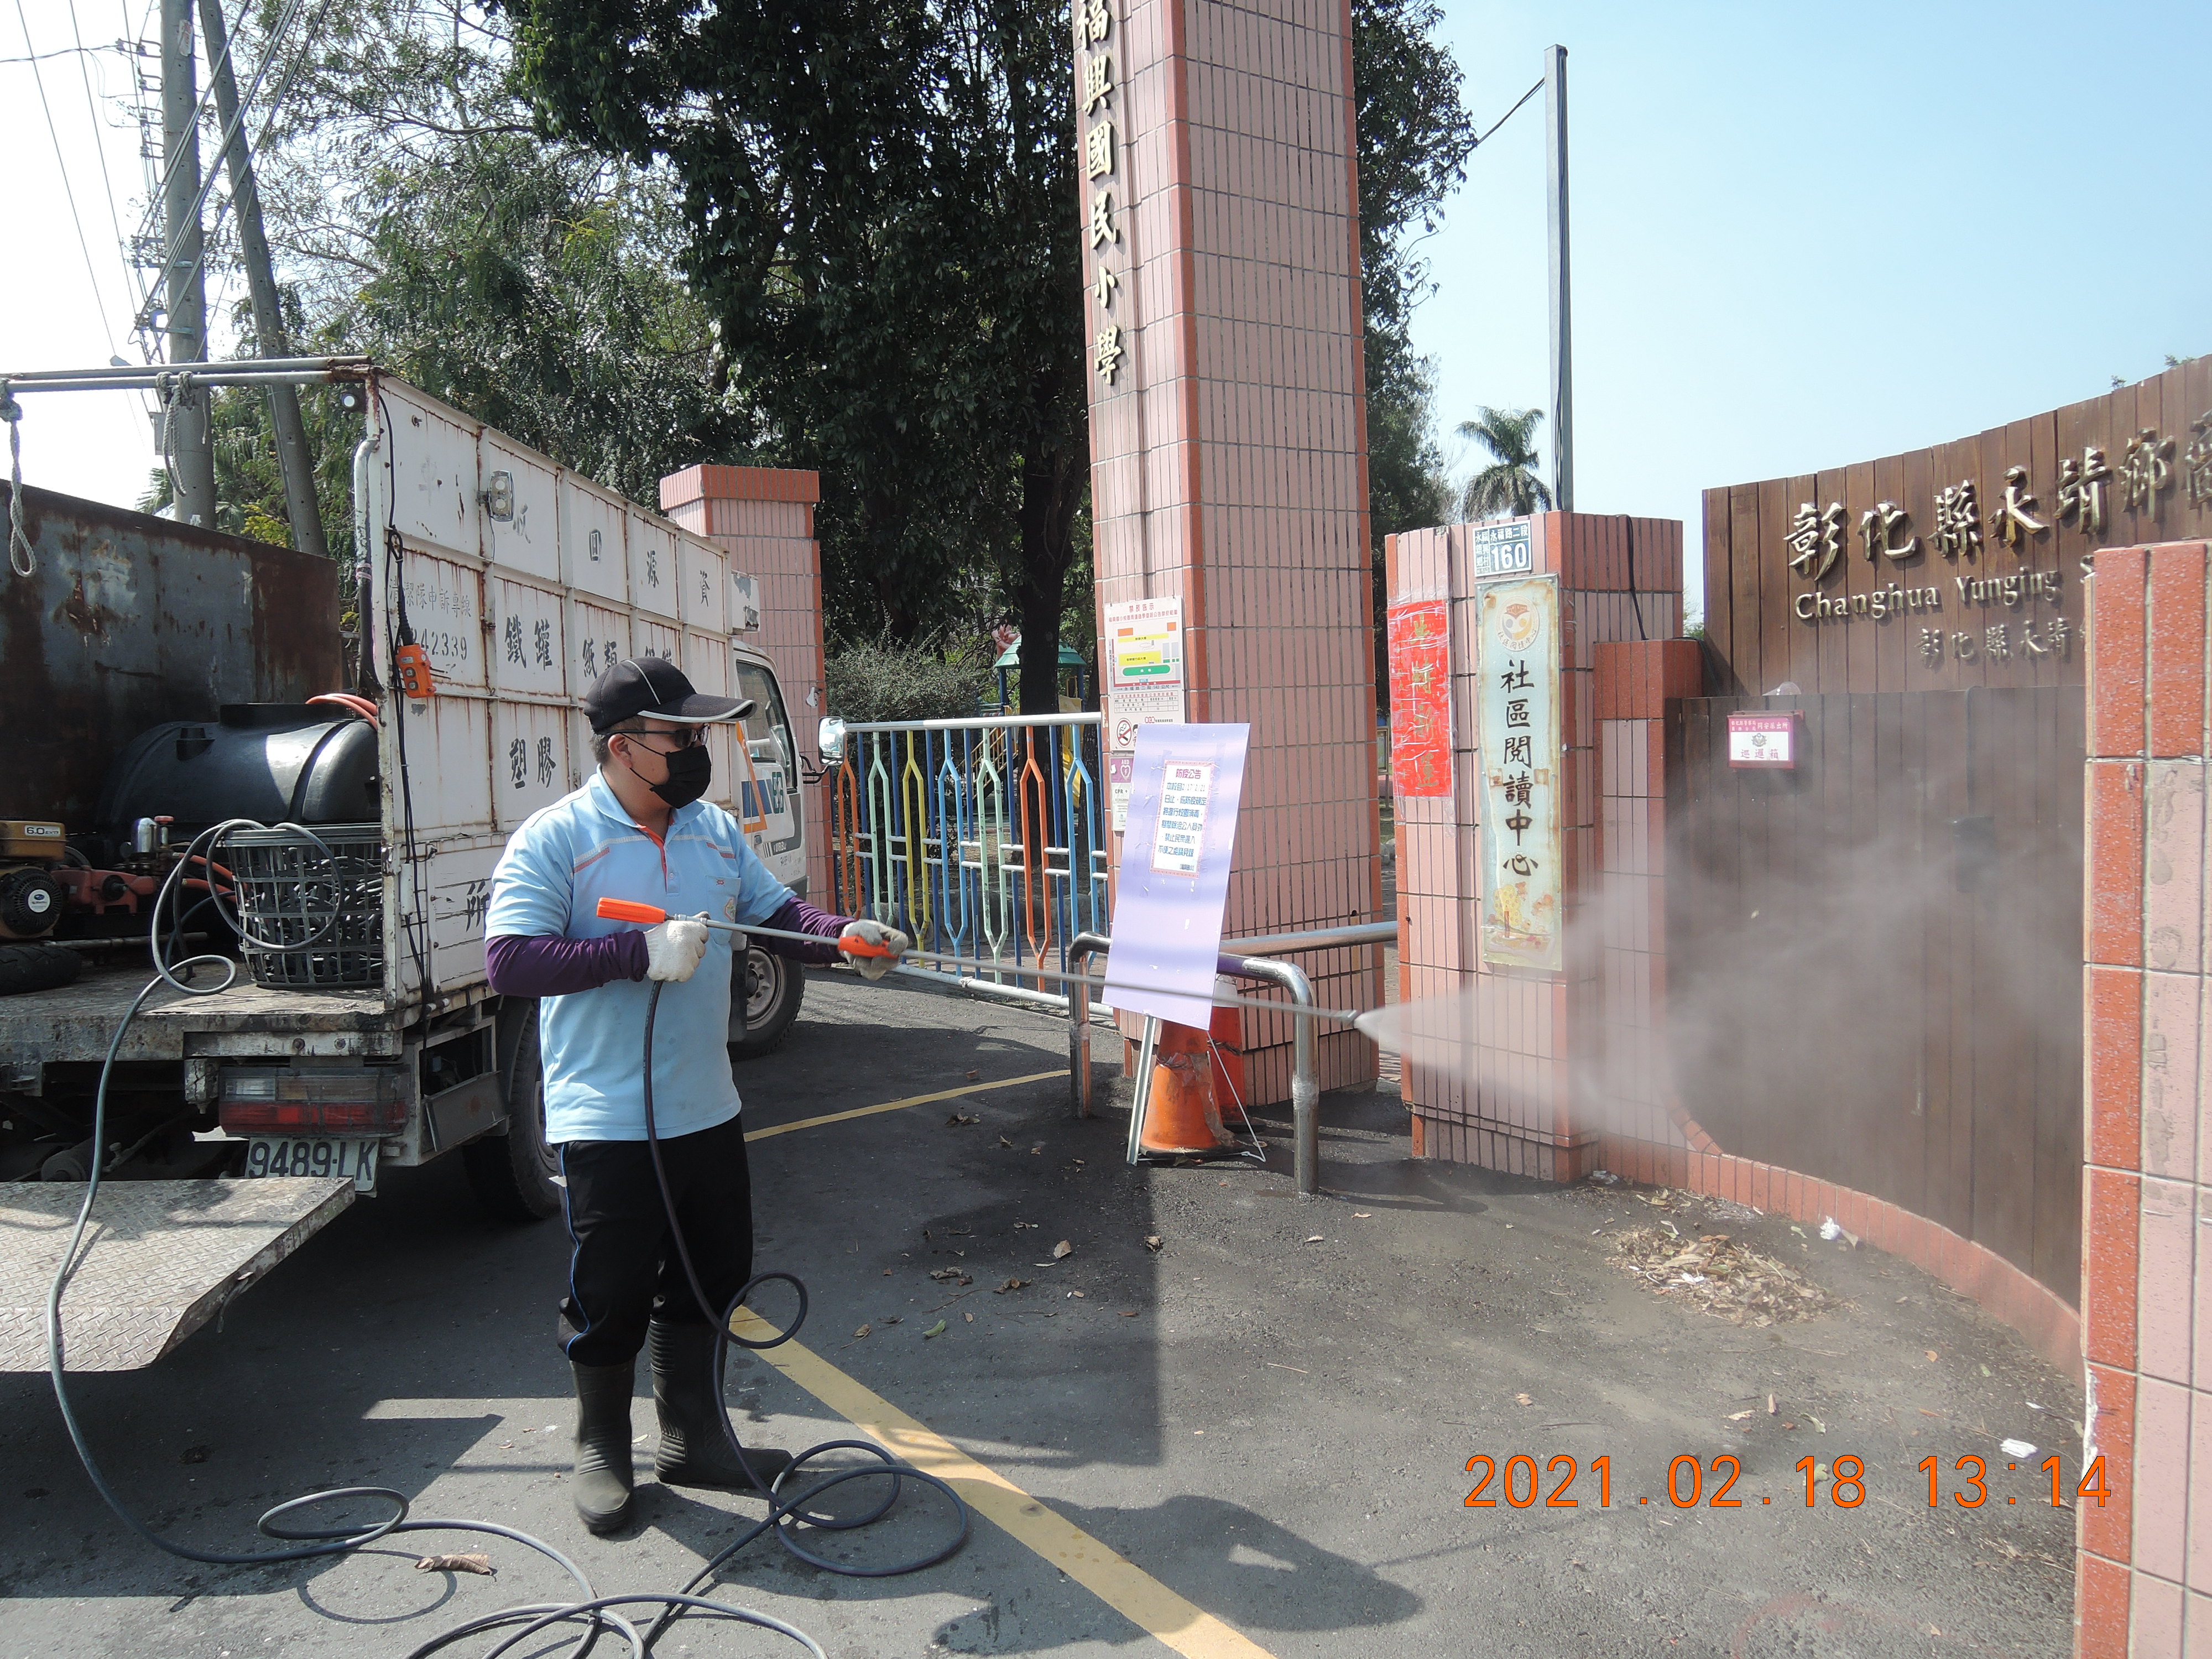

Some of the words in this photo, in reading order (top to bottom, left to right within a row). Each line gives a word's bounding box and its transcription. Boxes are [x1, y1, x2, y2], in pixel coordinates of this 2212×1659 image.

[1076, 0, 1125, 386] 福興國民小學
[1490, 524, 1528, 541] 永福路二段
[1491, 542, 1527, 571] 160
[1795, 583, 1941, 620] Changhua
[504, 614, 553, 669] 鐵罐
[1915, 617, 2086, 668] 彰化縣永靖
[509, 737, 556, 790] 塑膠
[1500, 659, 1538, 877] 社區閱讀中心
[1740, 748, 1779, 759] 巡邏箱
[1176, 769, 1202, 779] 防疫公告
[249, 1141, 377, 1181] 9489-LK
